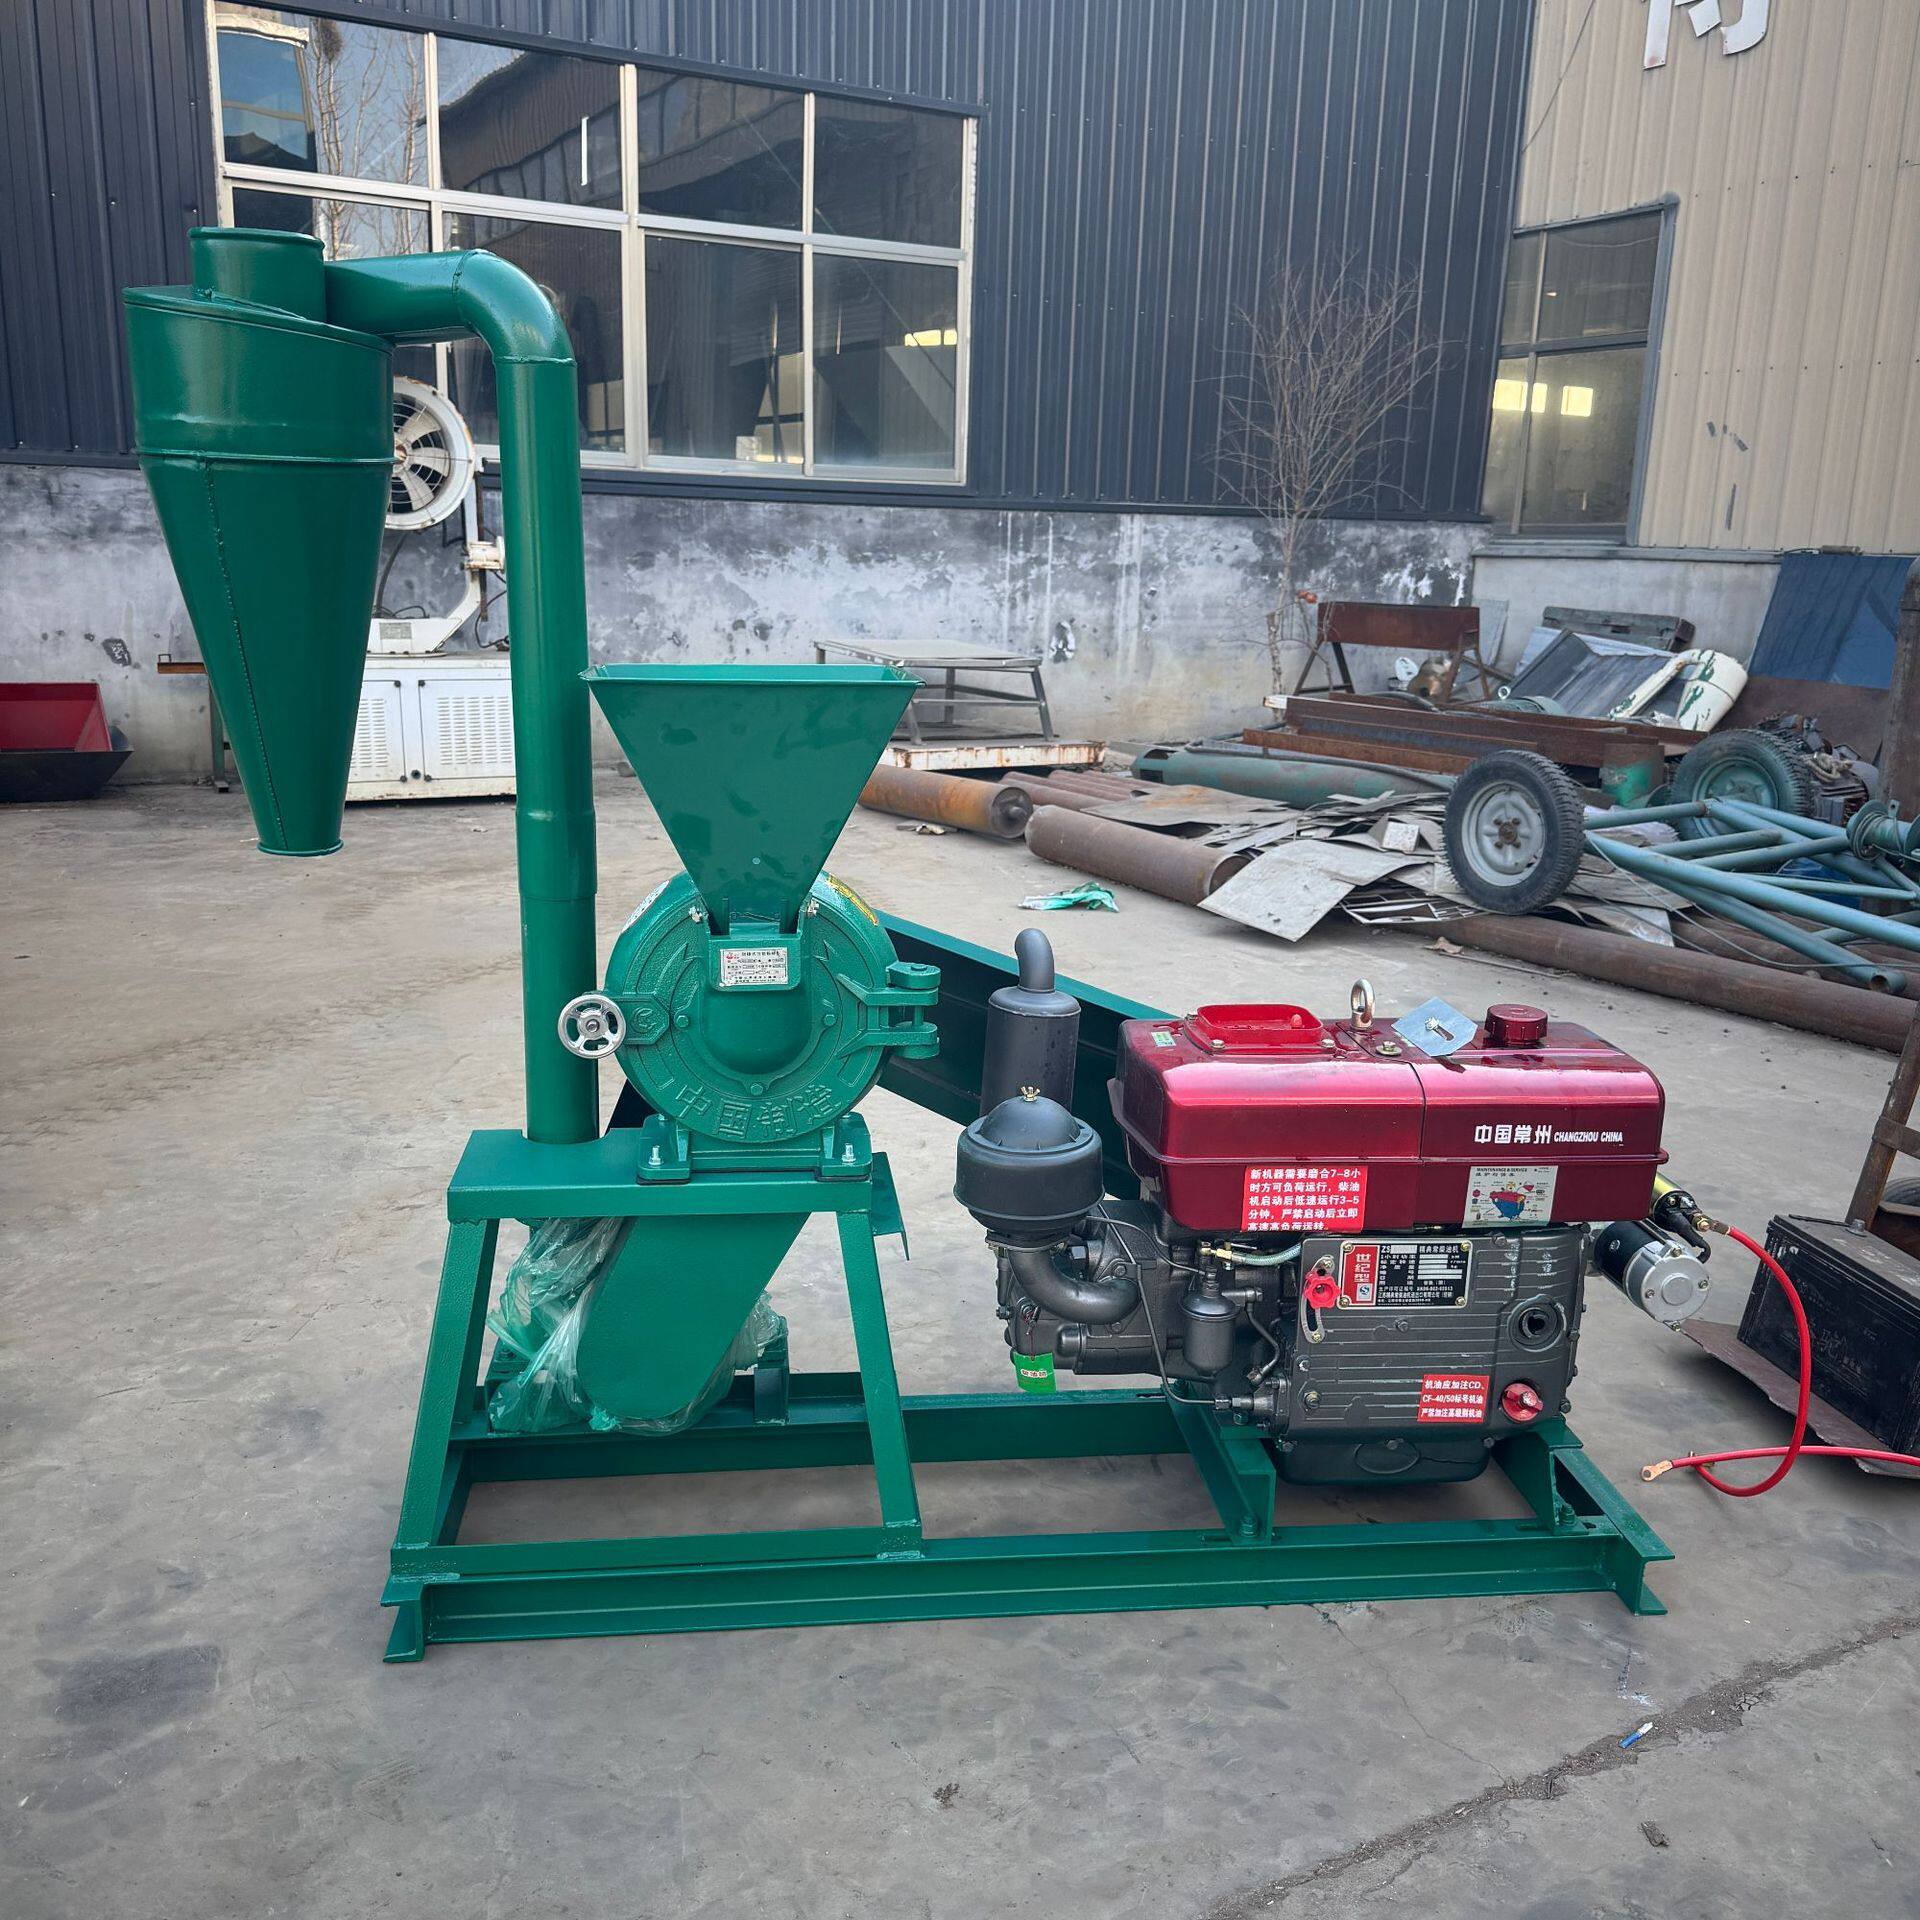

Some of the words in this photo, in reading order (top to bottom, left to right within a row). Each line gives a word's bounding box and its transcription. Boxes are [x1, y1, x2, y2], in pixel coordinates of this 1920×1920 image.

[1474, 1124, 1552, 1144] 中国常州
[1553, 1131, 1598, 1143] CHANGZHOU
[1600, 1131, 1623, 1143] CHINA
